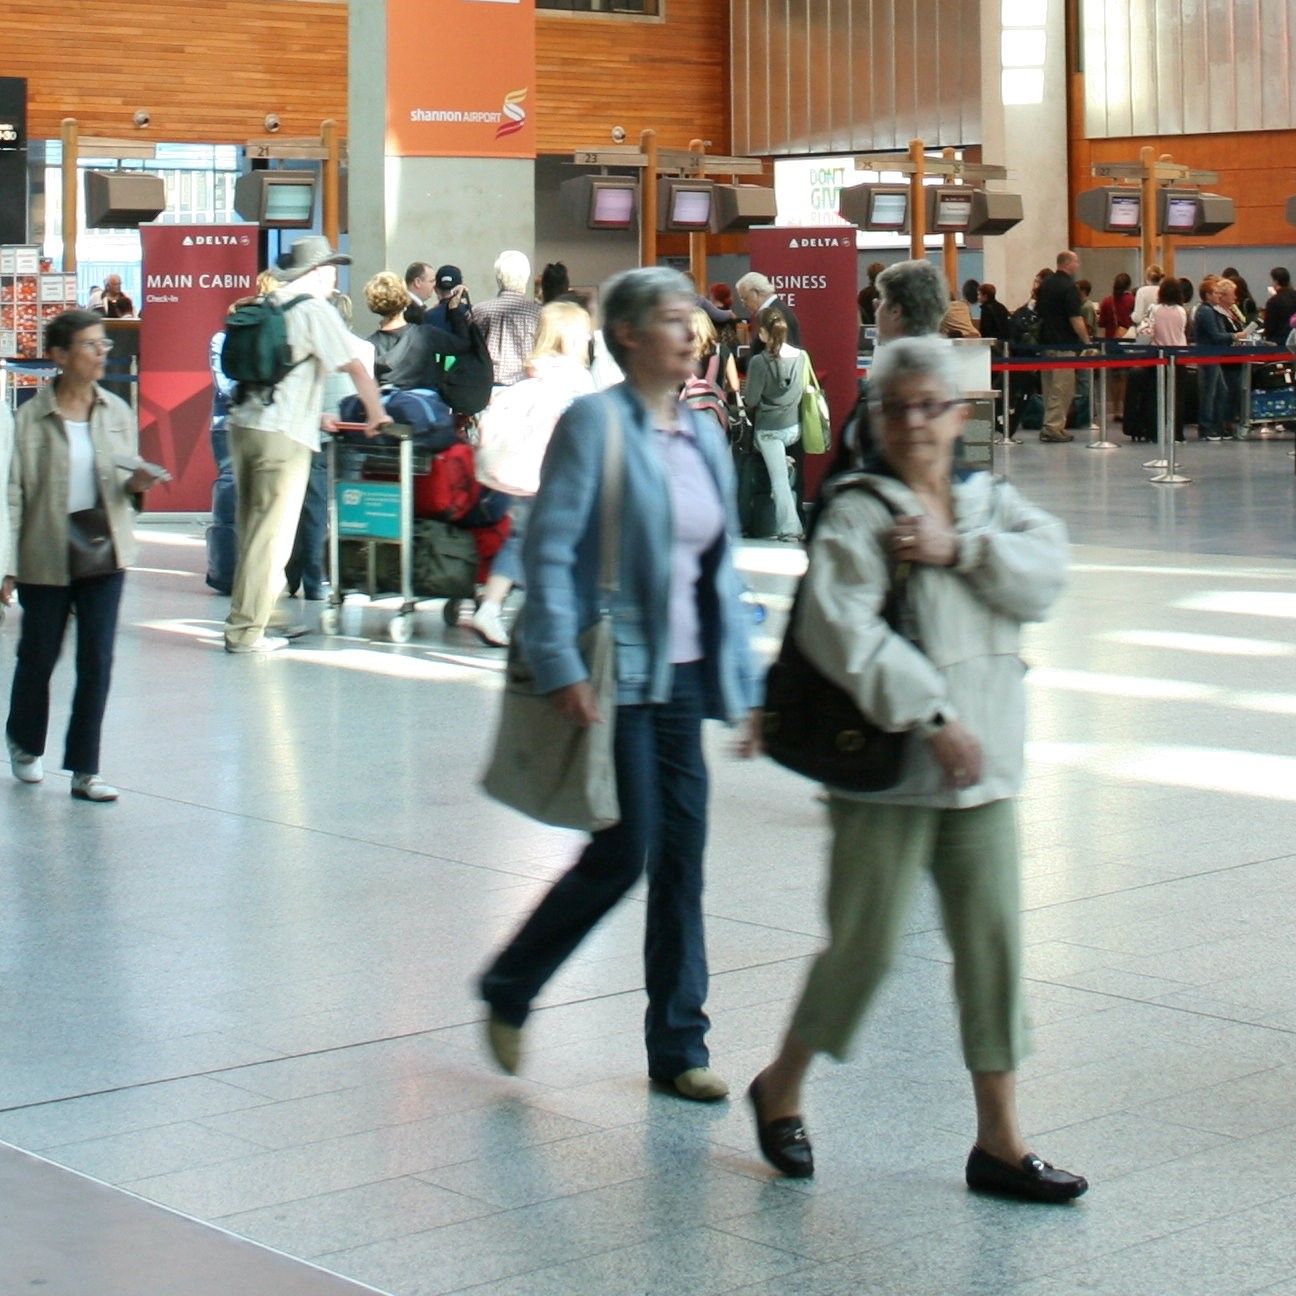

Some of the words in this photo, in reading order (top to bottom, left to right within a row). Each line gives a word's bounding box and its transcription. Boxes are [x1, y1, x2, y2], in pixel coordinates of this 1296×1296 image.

[410, 108, 462, 122] shannon
[463, 112, 502, 123] AIRPORT
[257, 145, 270, 157] 21
[584, 154, 597, 164] 23
[811, 187, 842, 210] GIV
[195, 236, 238, 245] DELTA
[801, 238, 839, 247] DELTA
[147, 274, 193, 288] MAIN
[198, 274, 251, 289] CABIN
